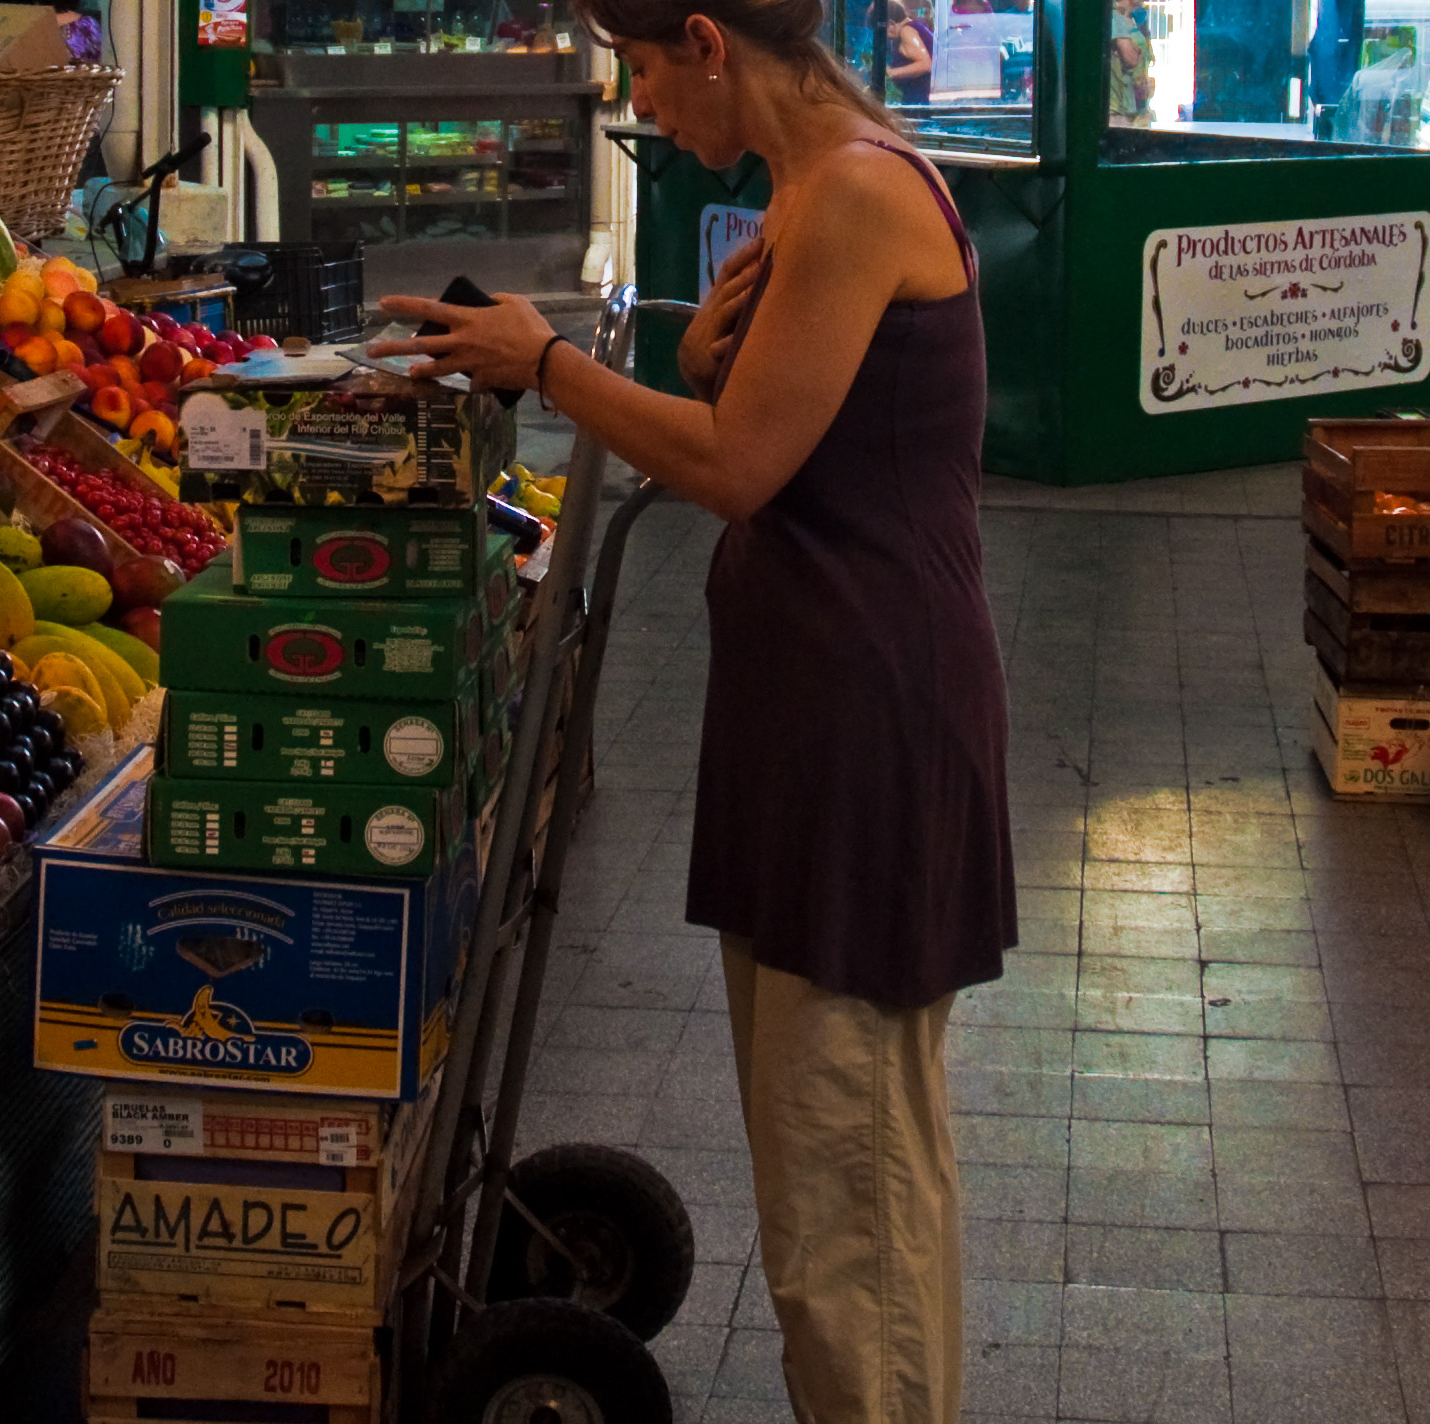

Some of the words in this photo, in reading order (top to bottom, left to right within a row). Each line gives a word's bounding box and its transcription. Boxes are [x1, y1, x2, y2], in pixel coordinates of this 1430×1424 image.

[1176, 229, 1289, 268] Productos
[1292, 224, 1407, 252] Artesanales
[1209, 261, 1227, 281] de
[1299, 253, 1317, 274] de
[1319, 249, 1377, 272] Córdoba
[1181, 318, 1229, 336] dulces
[1239, 309, 1318, 332] escabeches
[1329, 302, 1389, 325] alfajores
[1225, 331, 1299, 351] bocaditos
[1309, 324, 1359, 343] hongos
[1266, 348, 1319, 367] hierbas
[303, 411, 363, 424] Exportación
[364, 412, 379, 423] del
[381, 412, 407, 424] Valle
[334, 424, 349, 434] del
[370, 424, 407, 436] Chubut
[1363, 768, 1394, 785] DOS
[157, 899, 204, 921] Calidad
[206, 902, 286, 928] seleccionada
[158, 1067, 271, 1083] www.sabrostar.com
[112, 1103, 166, 1114] CIRUELAS
[112, 1111, 148, 1121] BLACK
[151, 1113, 189, 1123] AMBER
[110, 1133, 143, 1145] 9389
[110, 1191, 361, 1254] AMADEO
[131, 1349, 177, 1386] AÑO
[263, 1358, 321, 1395] 2010
